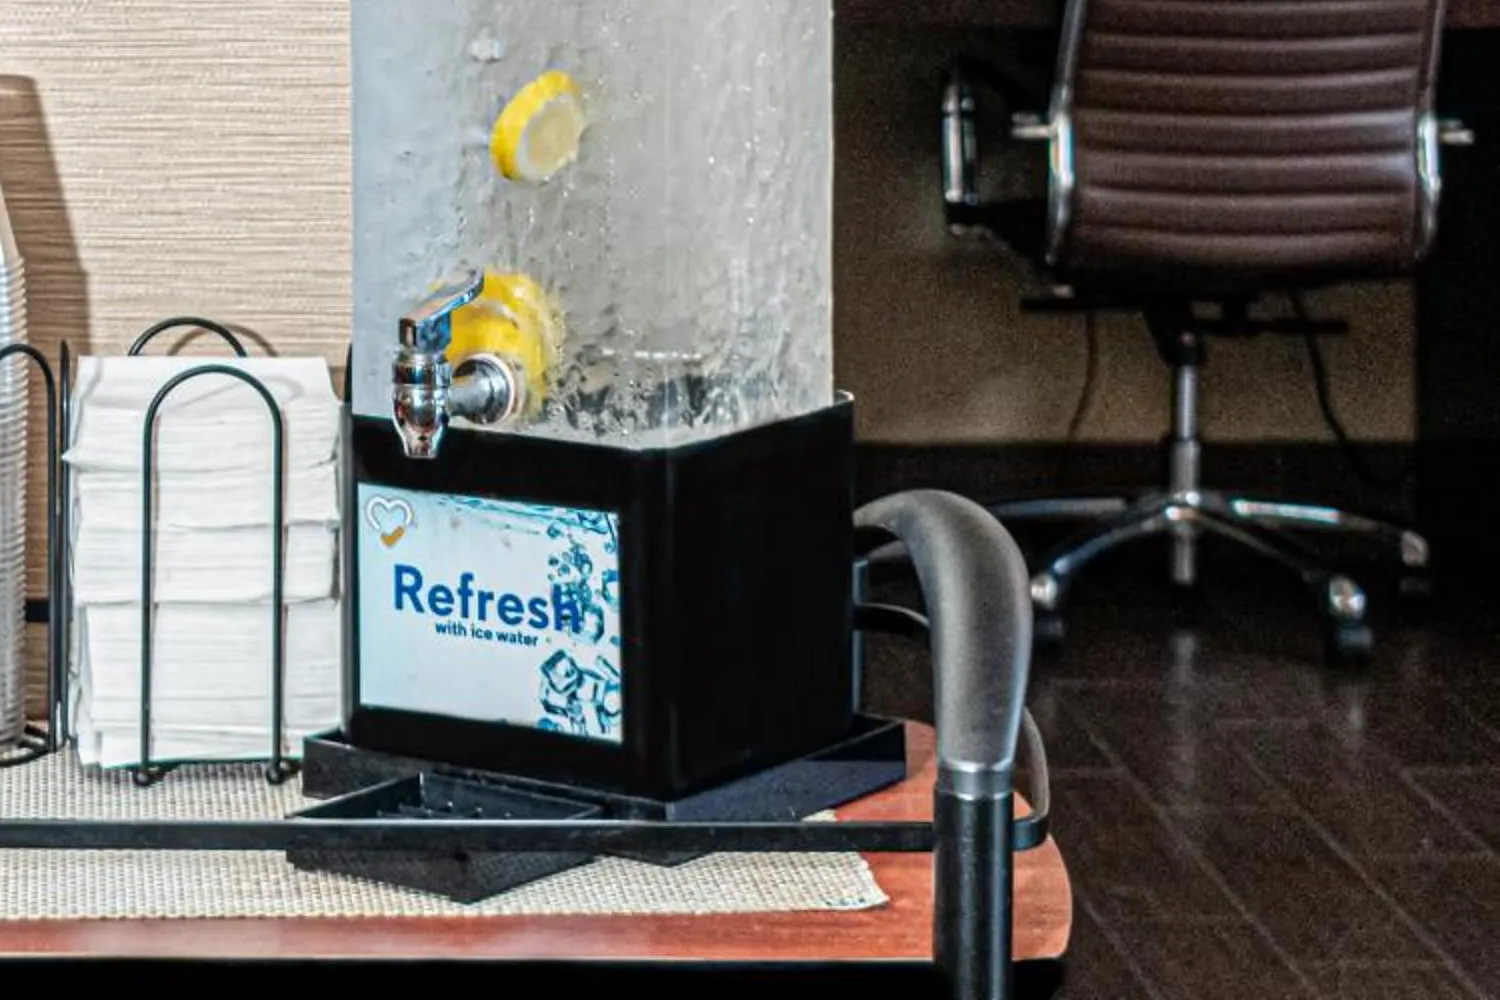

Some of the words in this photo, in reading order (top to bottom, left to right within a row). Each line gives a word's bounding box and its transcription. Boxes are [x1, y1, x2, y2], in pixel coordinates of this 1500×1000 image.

[393, 563, 582, 634] Refresh
[435, 619, 467, 637] with
[471, 622, 493, 640] ice
[496, 630, 538, 647] water
